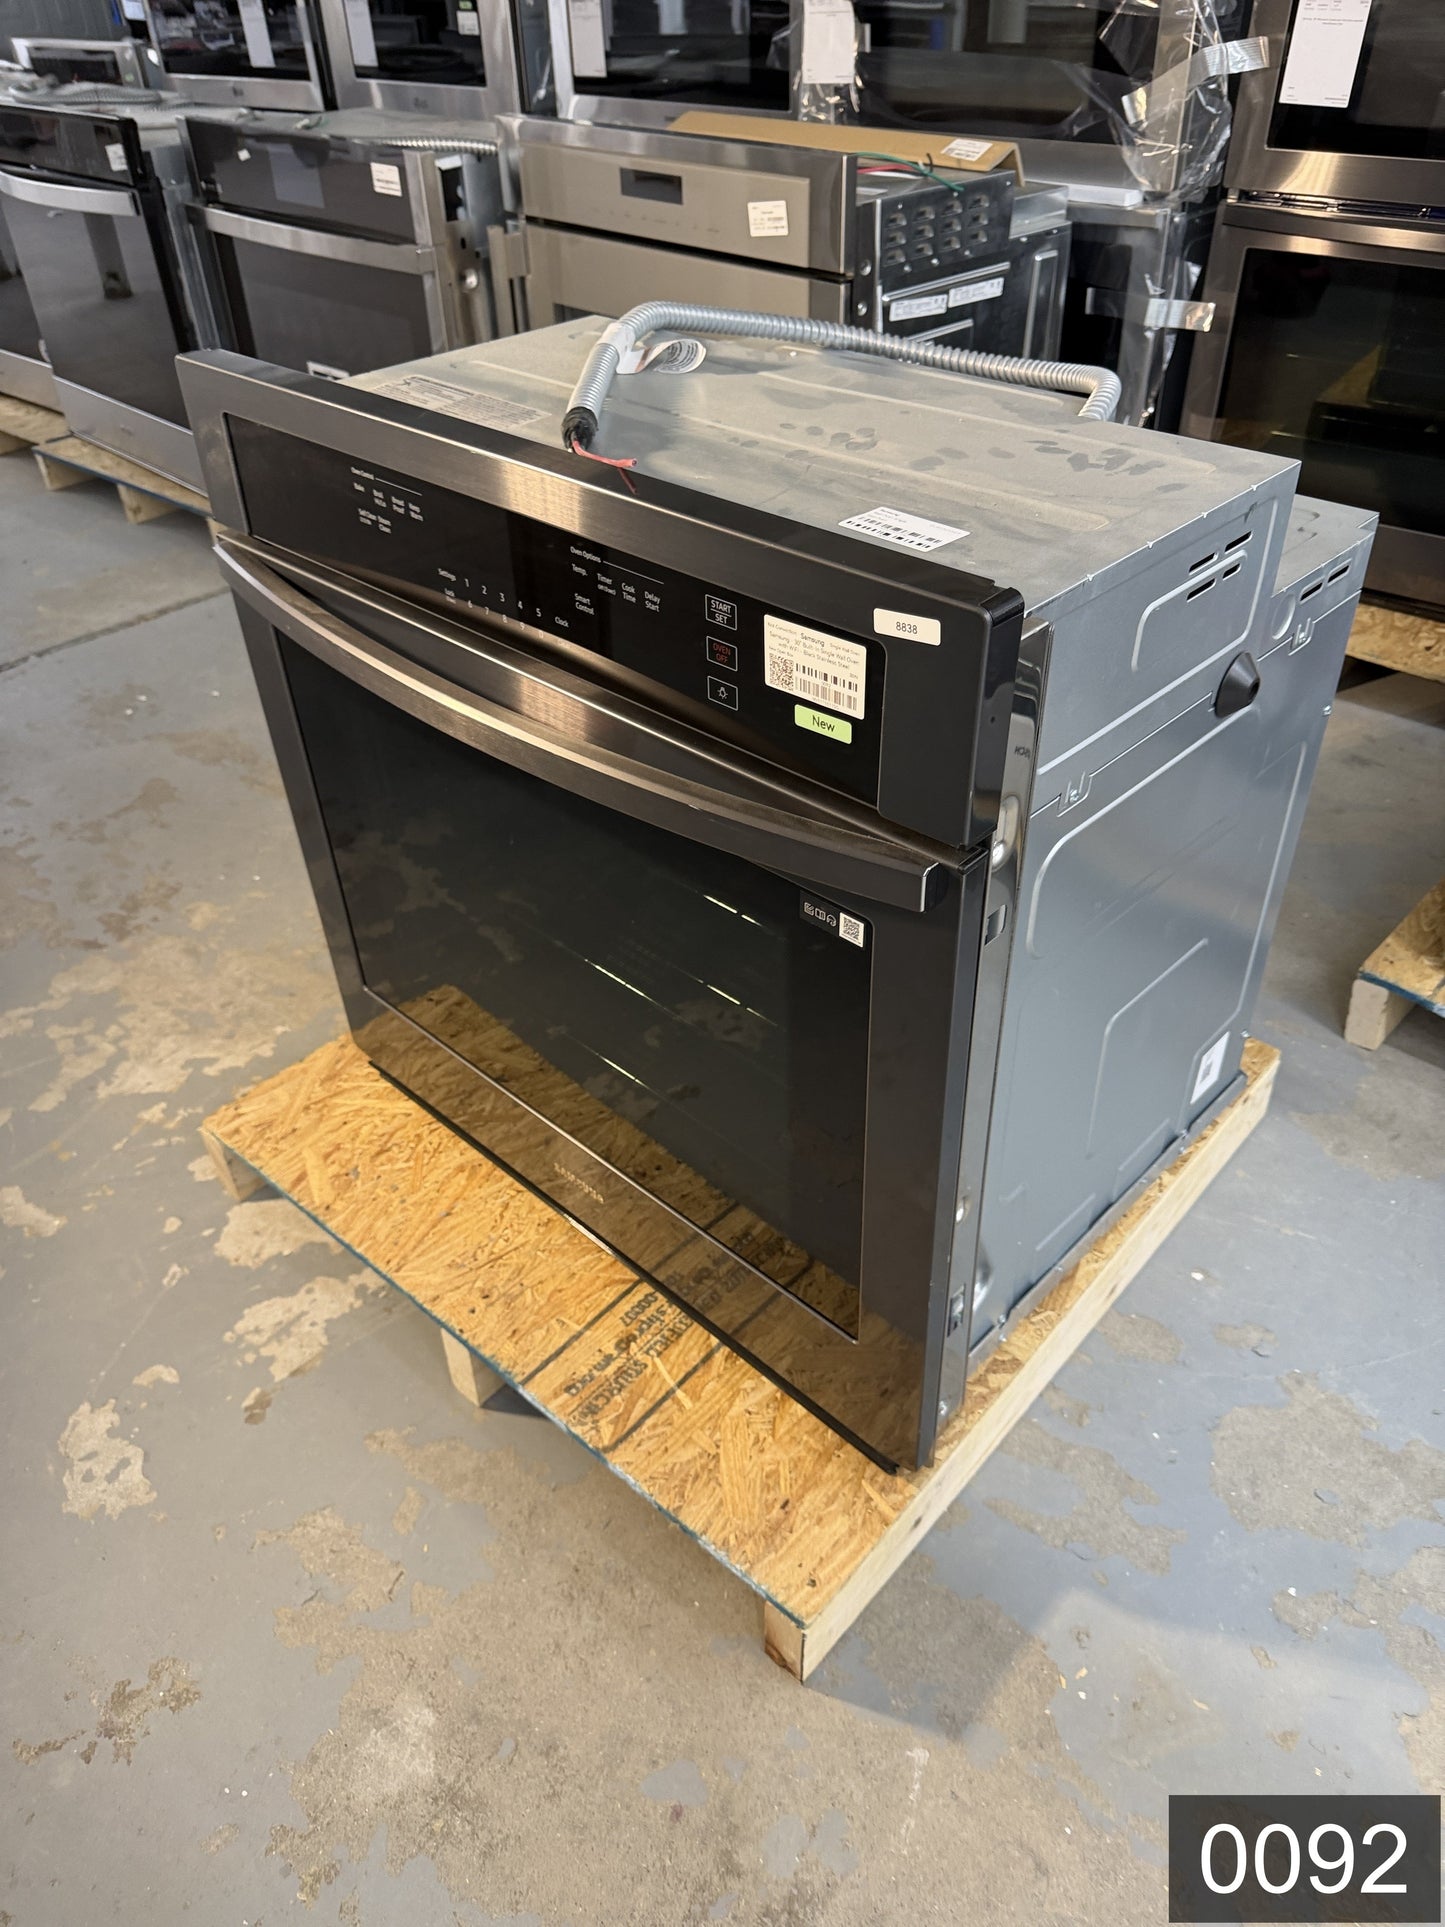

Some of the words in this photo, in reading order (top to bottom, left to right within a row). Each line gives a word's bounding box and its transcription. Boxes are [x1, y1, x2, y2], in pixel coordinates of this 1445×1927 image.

[570, 546, 582, 556] Oven
[582, 550, 602, 563] Options
[597, 573, 612, 585] Timer
[621, 582, 635, 593] Cook
[481, 585, 488, 595] 2
[499, 592, 505, 602] 3
[517, 600, 523, 610] 4
[535, 607, 542, 617] 5
[622, 591, 637, 603] Time
[644, 590, 661, 604] Delay
[645, 600, 660, 612] Start
[710, 599, 732, 614] START
[554, 616, 570, 628] Clock
[714, 613, 728, 625] SET
[896, 621, 918, 635] 8838
[800, 632, 825, 648] Samsung
[712, 642, 731, 656] OVEN
[812, 714, 836, 733] New
